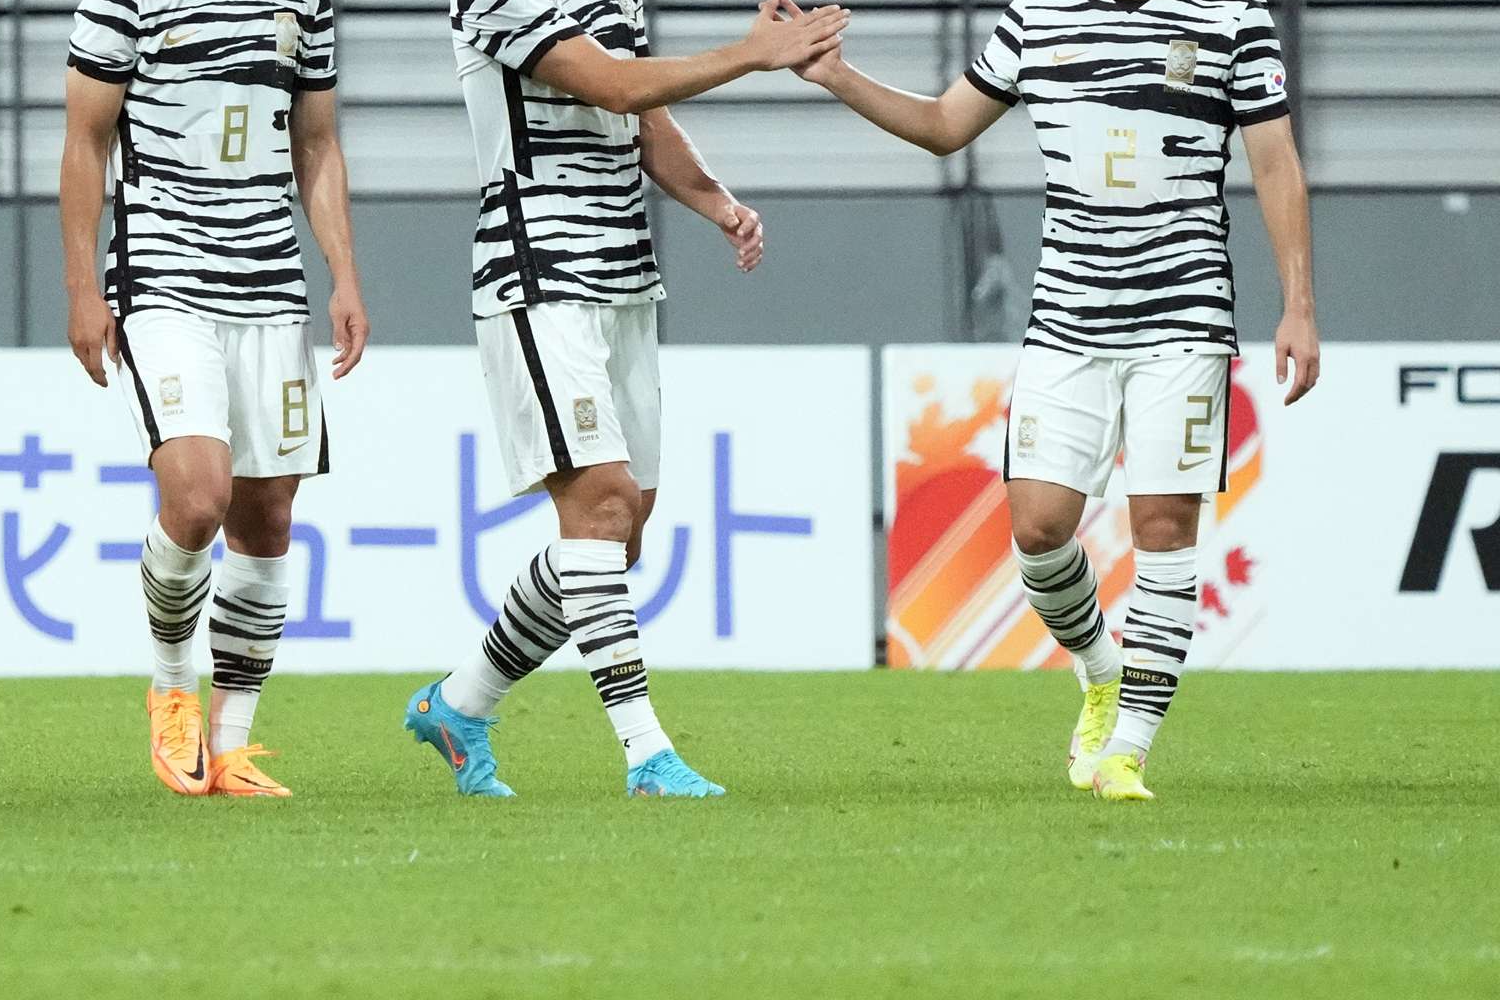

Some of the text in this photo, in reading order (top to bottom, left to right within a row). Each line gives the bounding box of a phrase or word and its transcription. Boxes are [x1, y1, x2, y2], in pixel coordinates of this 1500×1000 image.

[220, 104, 249, 162] 8
[1104, 128, 1137, 189] 2
[282, 379, 309, 438] 8
[1184, 396, 1213, 453] 2
[1126, 669, 1169, 686] KOREA
